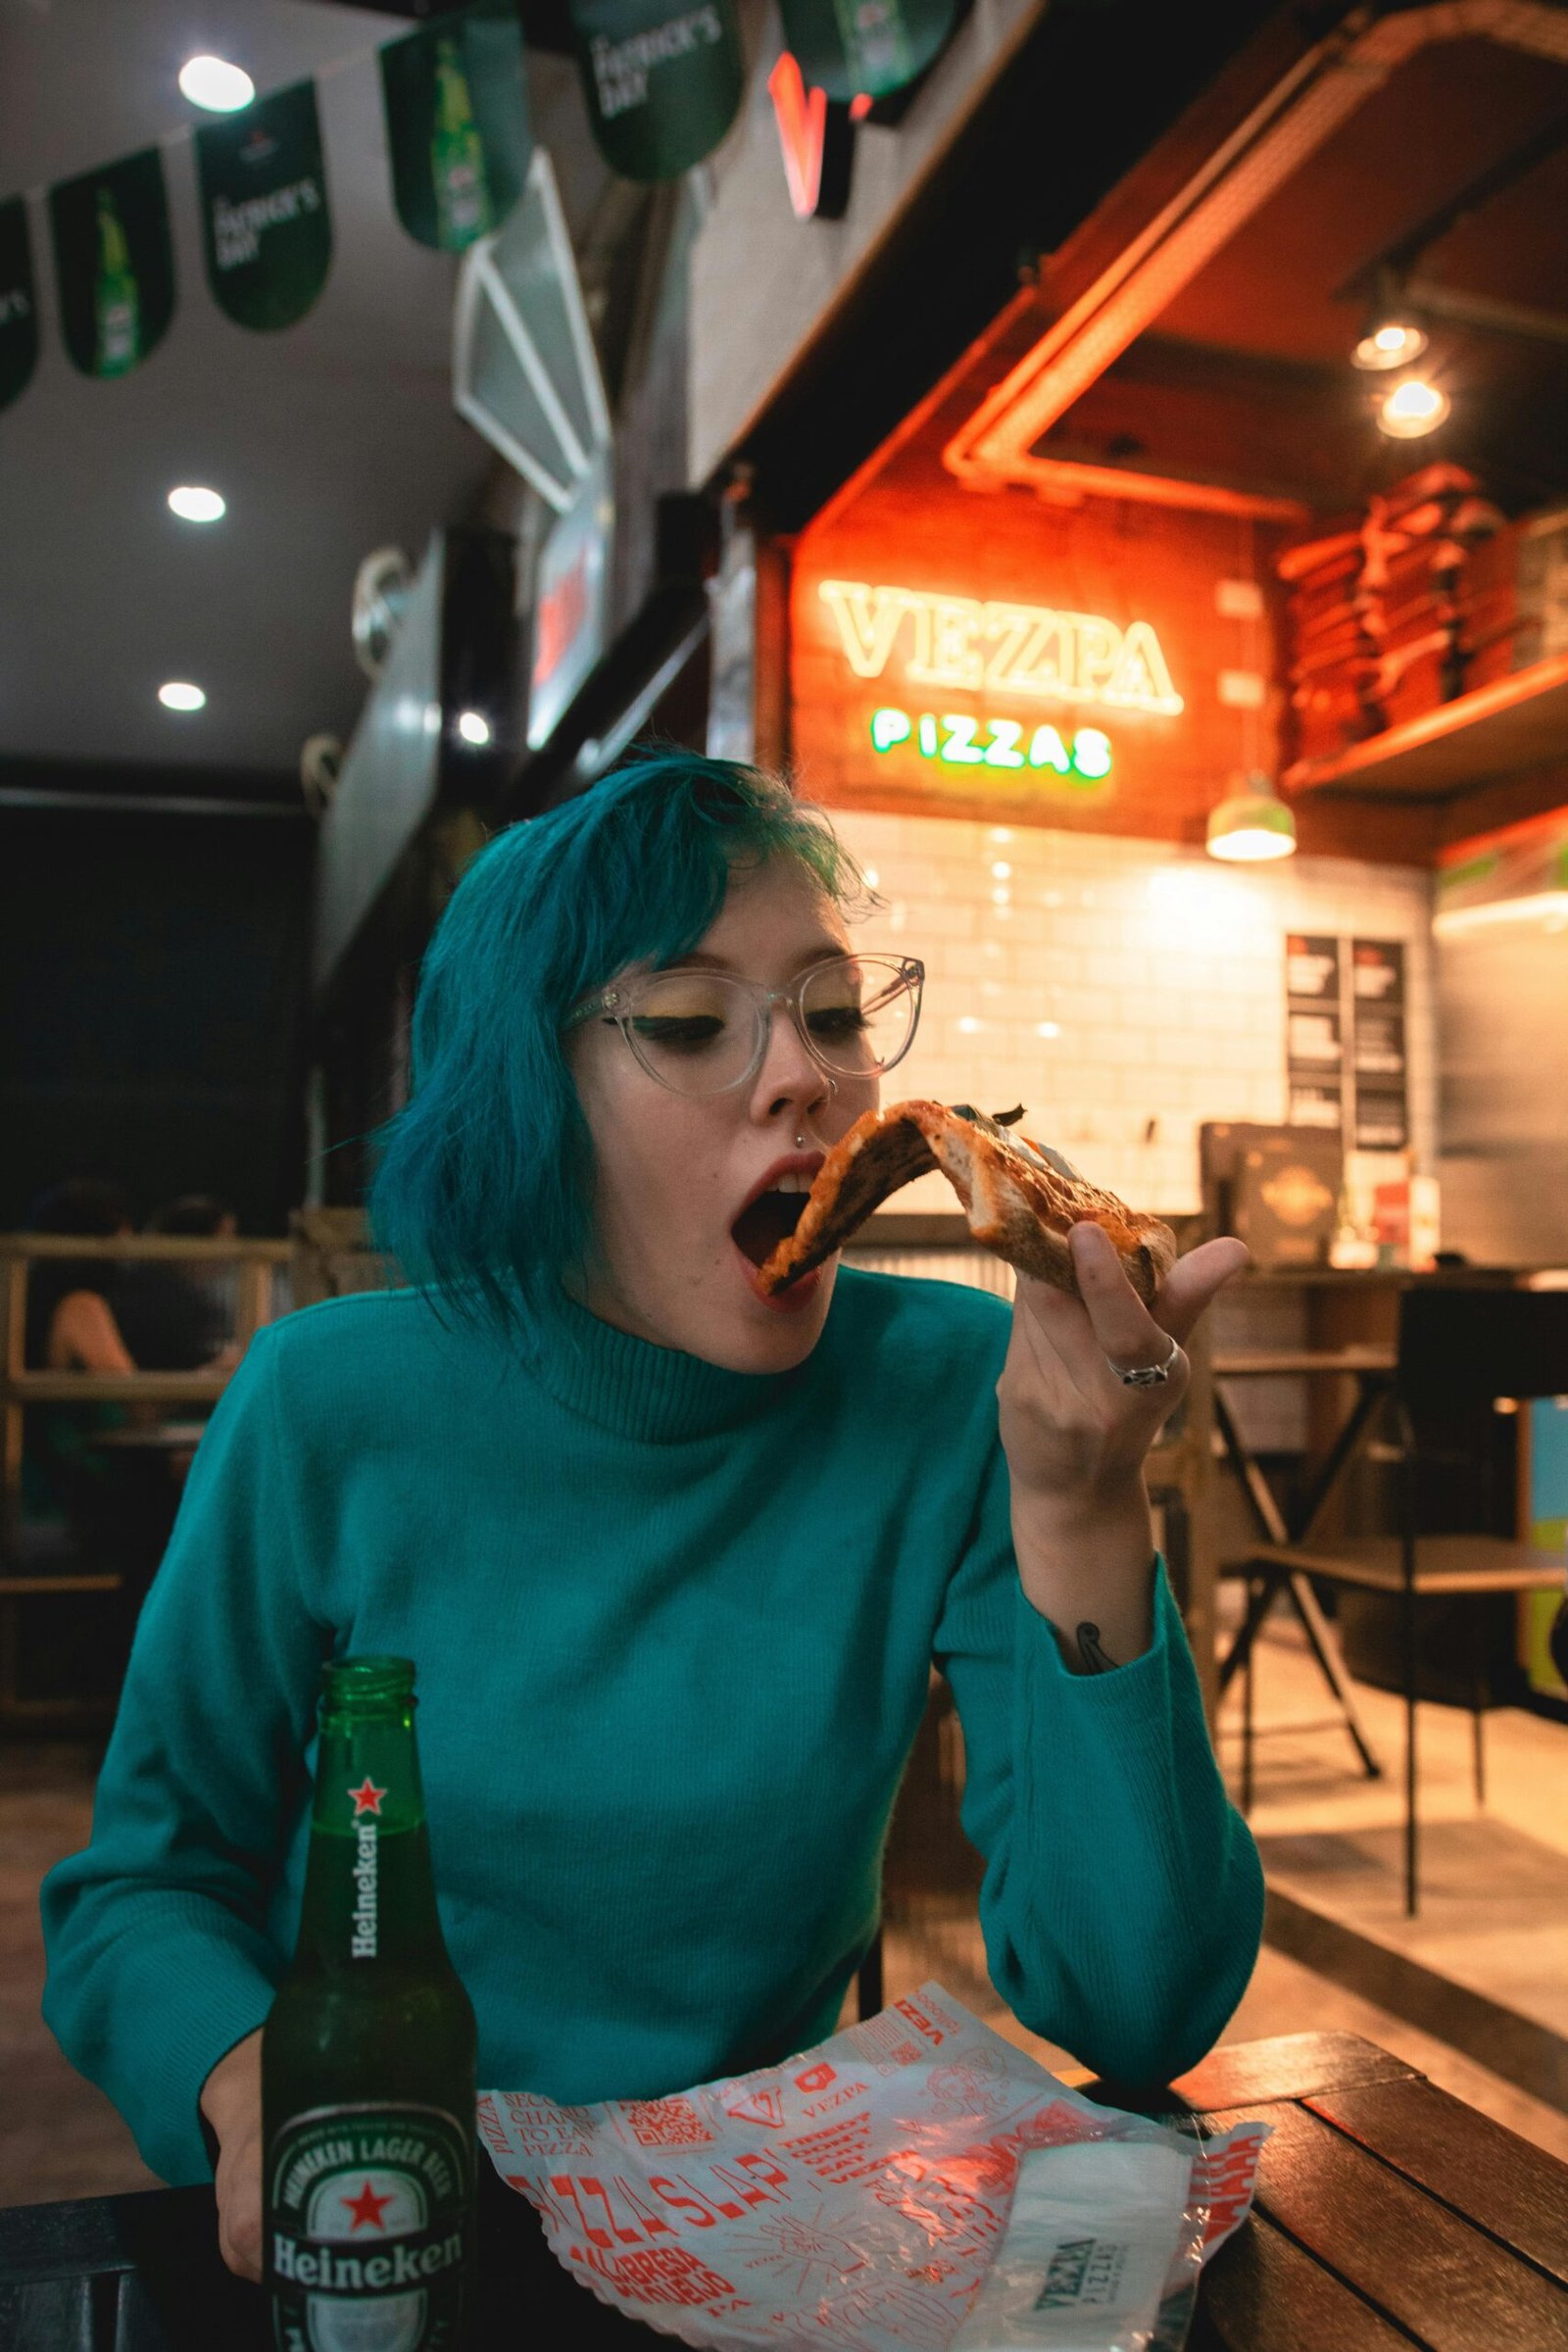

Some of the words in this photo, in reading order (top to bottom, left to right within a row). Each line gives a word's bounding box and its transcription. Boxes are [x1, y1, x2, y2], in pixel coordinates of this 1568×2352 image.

[818, 579, 1184, 715] VEZPA
[870, 708, 1111, 778] PIZZAS
[352, 1824, 378, 1958] Heineken
[360, 2136, 426, 2165] LAGER
[273, 2231, 463, 2289] Heineken
